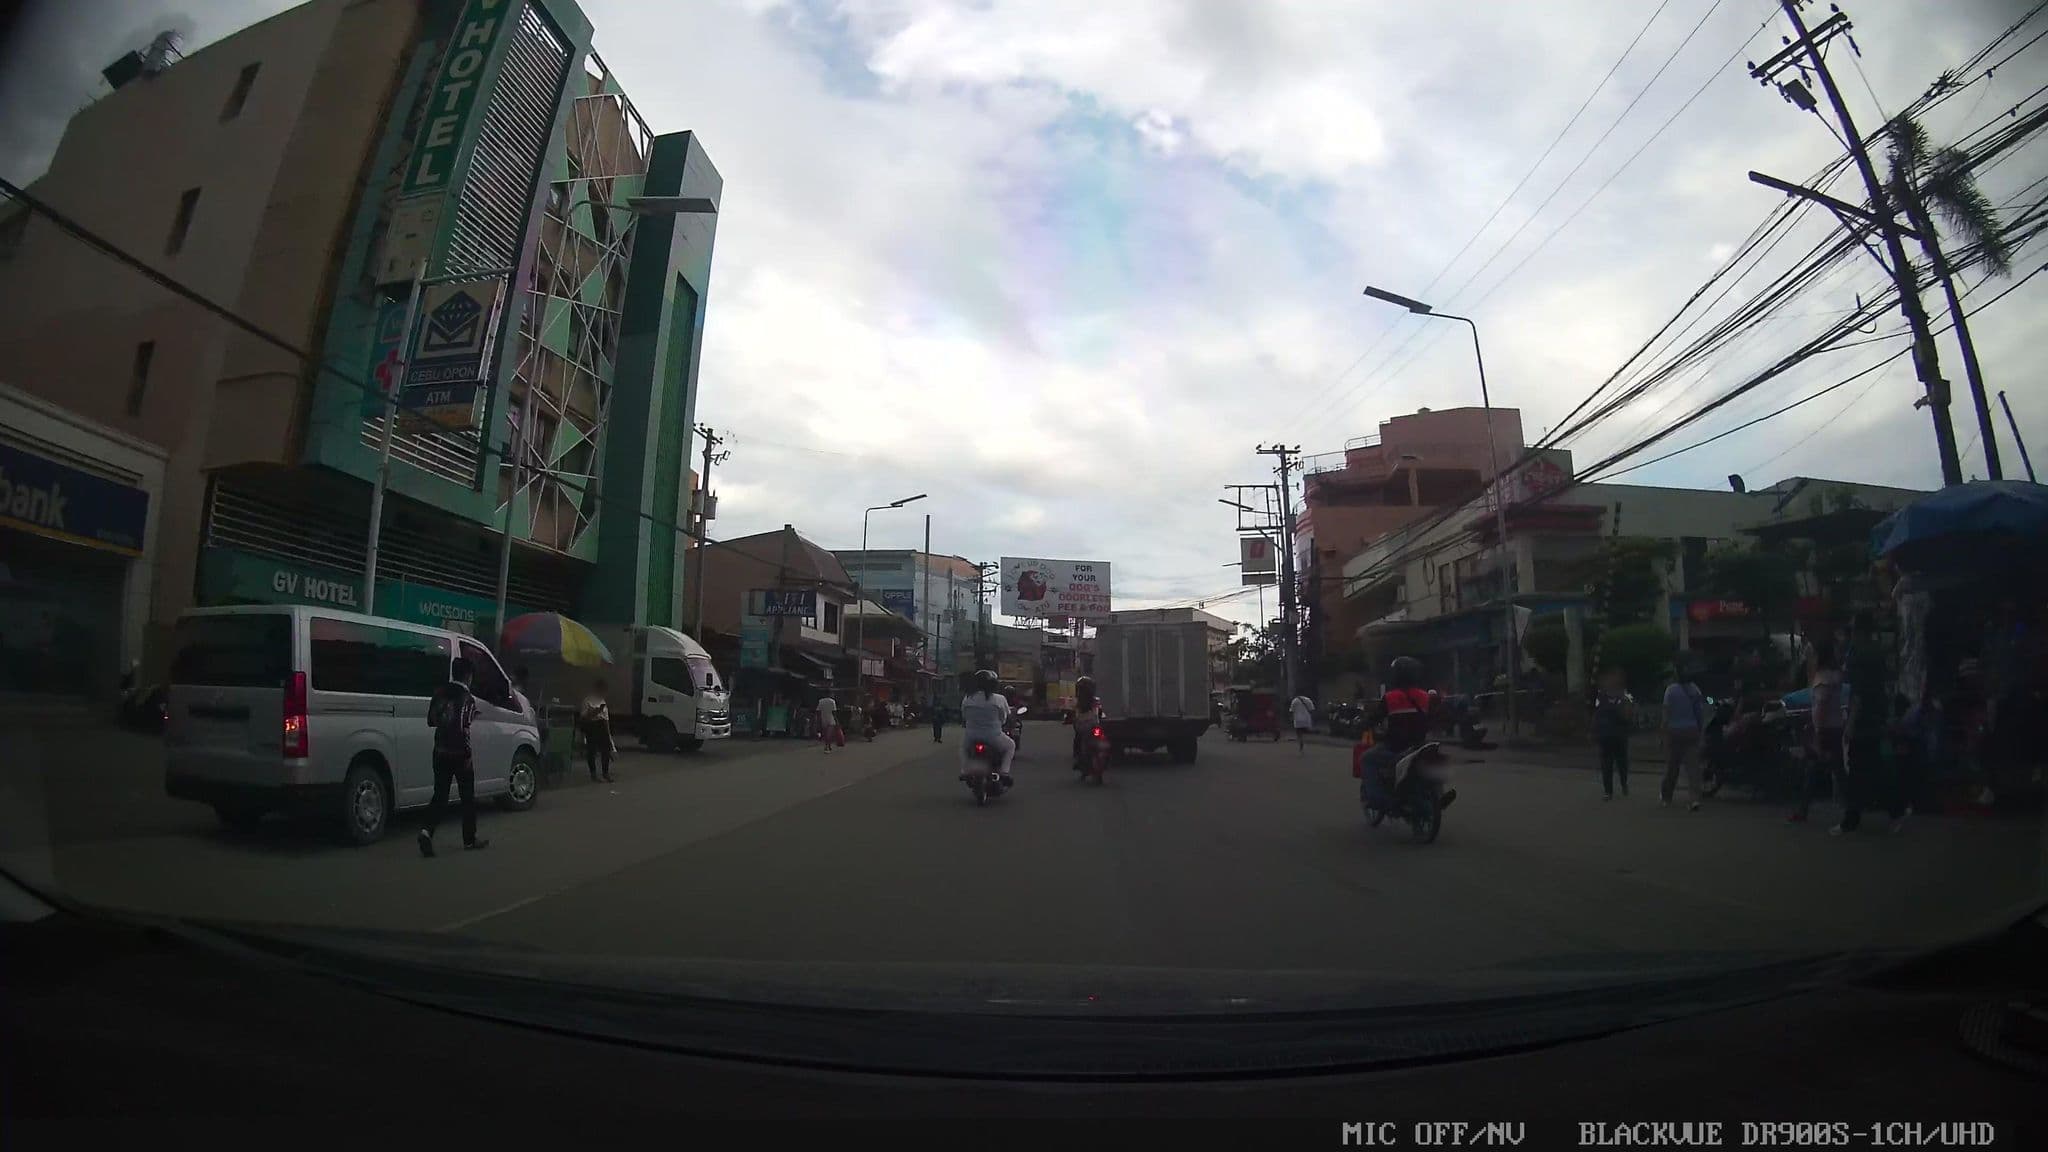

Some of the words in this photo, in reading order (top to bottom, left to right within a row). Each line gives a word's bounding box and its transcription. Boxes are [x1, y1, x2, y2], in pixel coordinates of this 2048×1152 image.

[415, 18, 497, 186] HOTEL
[443, 366, 476, 380] OPON
[426, 391, 451, 405] ATM
[1075, 564, 1093, 572] FOR
[1072, 574, 1097, 582] YOUR
[274, 571, 299, 593] GV
[303, 576, 357, 606] HOTEL
